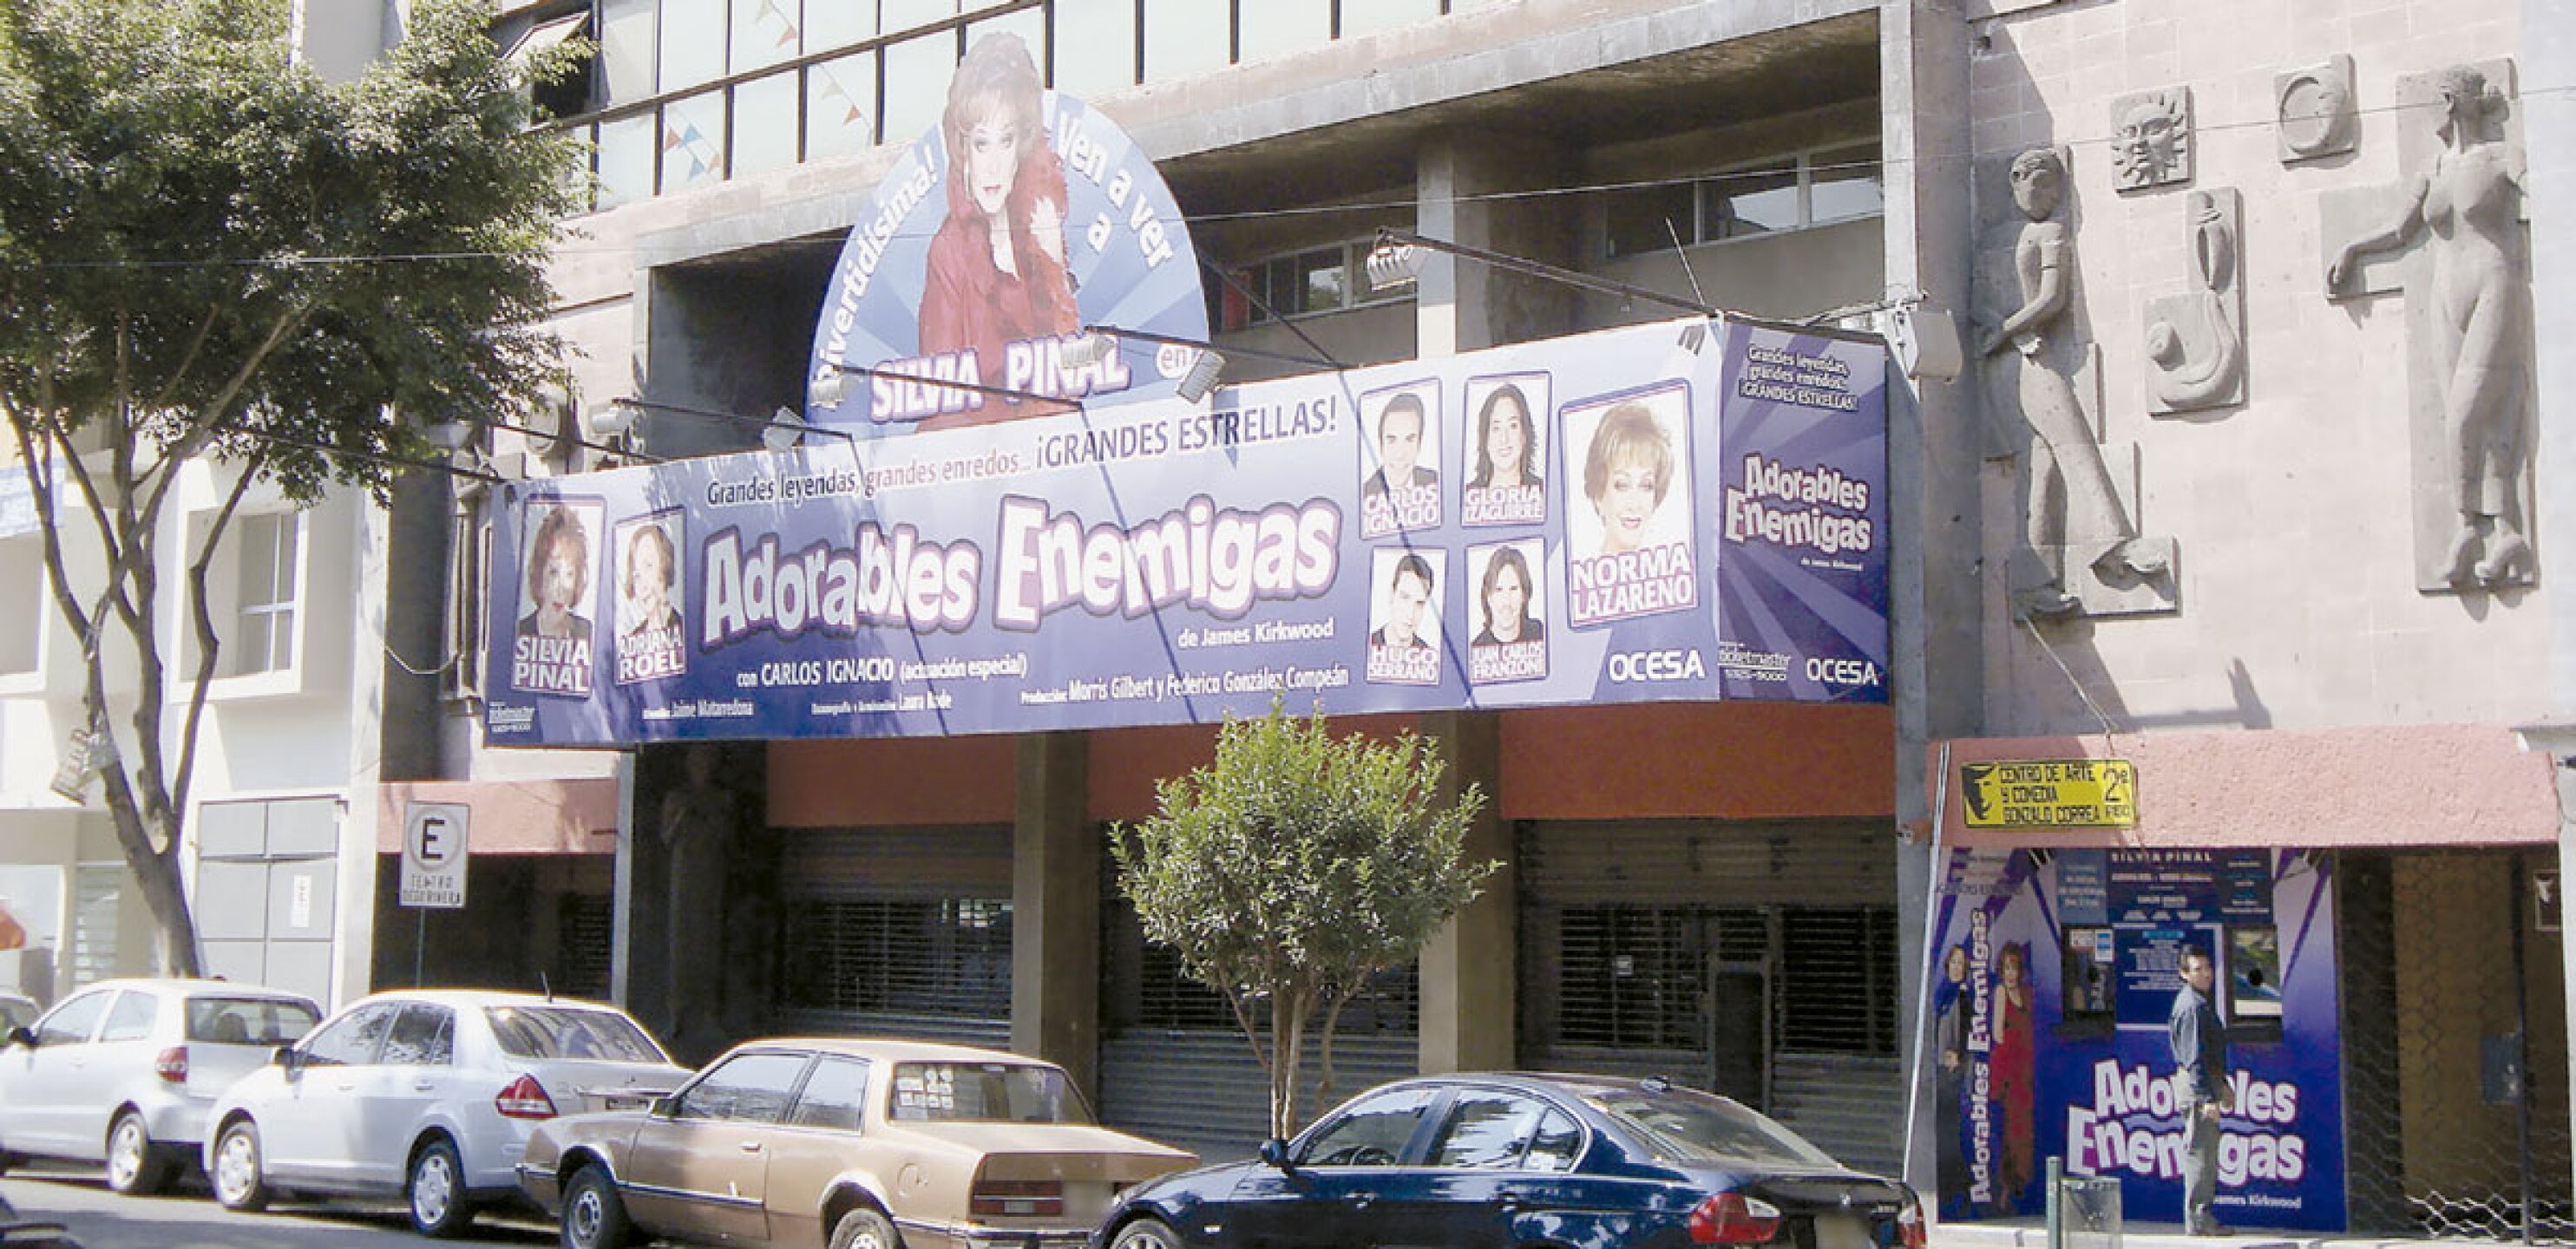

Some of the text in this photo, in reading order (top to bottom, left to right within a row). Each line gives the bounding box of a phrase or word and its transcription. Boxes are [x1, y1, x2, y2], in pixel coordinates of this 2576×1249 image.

[1058, 111, 1173, 268] Ven a ver
[1087, 211, 1111, 252] a
[871, 350, 981, 419] SILVIA
[706, 477, 775, 506] Grandes
[780, 468, 861, 505] leyendas,
[864, 462, 938, 497] grandes
[1036, 420, 1169, 469] ¡GRANDES
[1177, 395, 1338, 451] ESTRELLAS!
[1467, 484, 1541, 507] GLORIA
[1744, 454, 1869, 511] Adorables
[1724, 486, 1871, 553] Enemigas
[701, 494, 1341, 651] Adorables Enemigas
[1573, 544, 1691, 589] NORMA
[1573, 574, 1692, 618] LAZARENO
[514, 636, 591, 667] SILVIA
[1177, 617, 1334, 648] de James Kirkwood
[619, 648, 685, 681] ROEL
[737, 672, 758, 687] con
[760, 662, 822, 686] CARLOS
[825, 657, 895, 683] IGNACIO
[967, 651, 1028, 682] especial)
[1371, 644, 1437, 664] HUGO
[1609, 650, 1707, 683] OCESA
[1806, 657, 1879, 686] OCESA
[514, 662, 590, 691] PINAL
[1068, 678, 1109, 703] Morris
[1111, 676, 1155, 700] Gilbert
[1156, 681, 1164, 703] y
[1167, 671, 1220, 696] Federico
[1223, 666, 1283, 693] González
[1286, 663, 1350, 693] Compeán
[1998, 765, 2042, 783] CENTRO
[2045, 764, 2061, 782] DE
[2065, 763, 2096, 782] ARTE
[2002, 804, 2101, 824] GONZALO CORREA
[2012, 785, 2059, 803] COMEDIA
[421, 818, 445, 860] E
[2111, 851, 2212, 862] SILVIA PINAL
[1968, 907, 1991, 1203] Adorables Enemigas
[2094, 1057, 2300, 1125] Adorles
[2066, 1104, 2306, 1187] Enemgas
